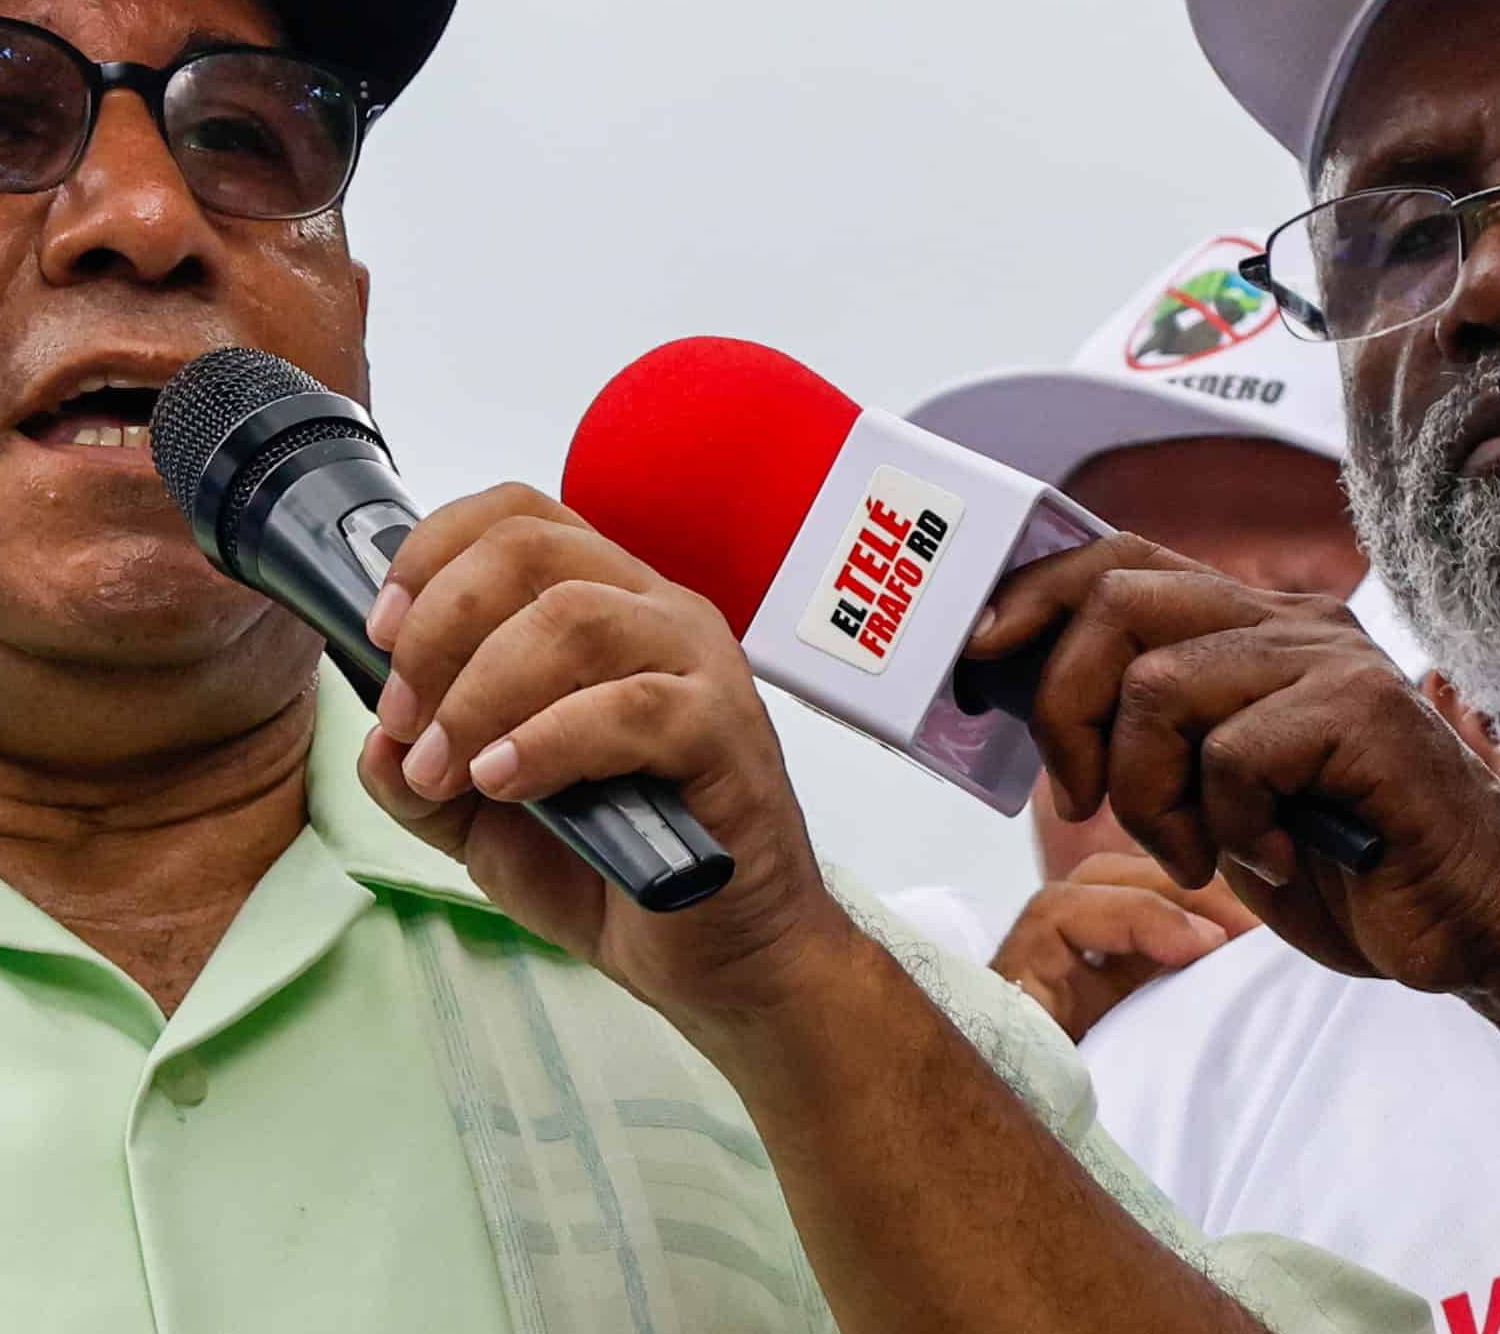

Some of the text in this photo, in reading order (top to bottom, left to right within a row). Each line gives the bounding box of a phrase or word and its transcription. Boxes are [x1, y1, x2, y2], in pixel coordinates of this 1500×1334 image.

[830, 495, 912, 638] EL TELÉ
[858, 509, 949, 658] FRAFO RD
